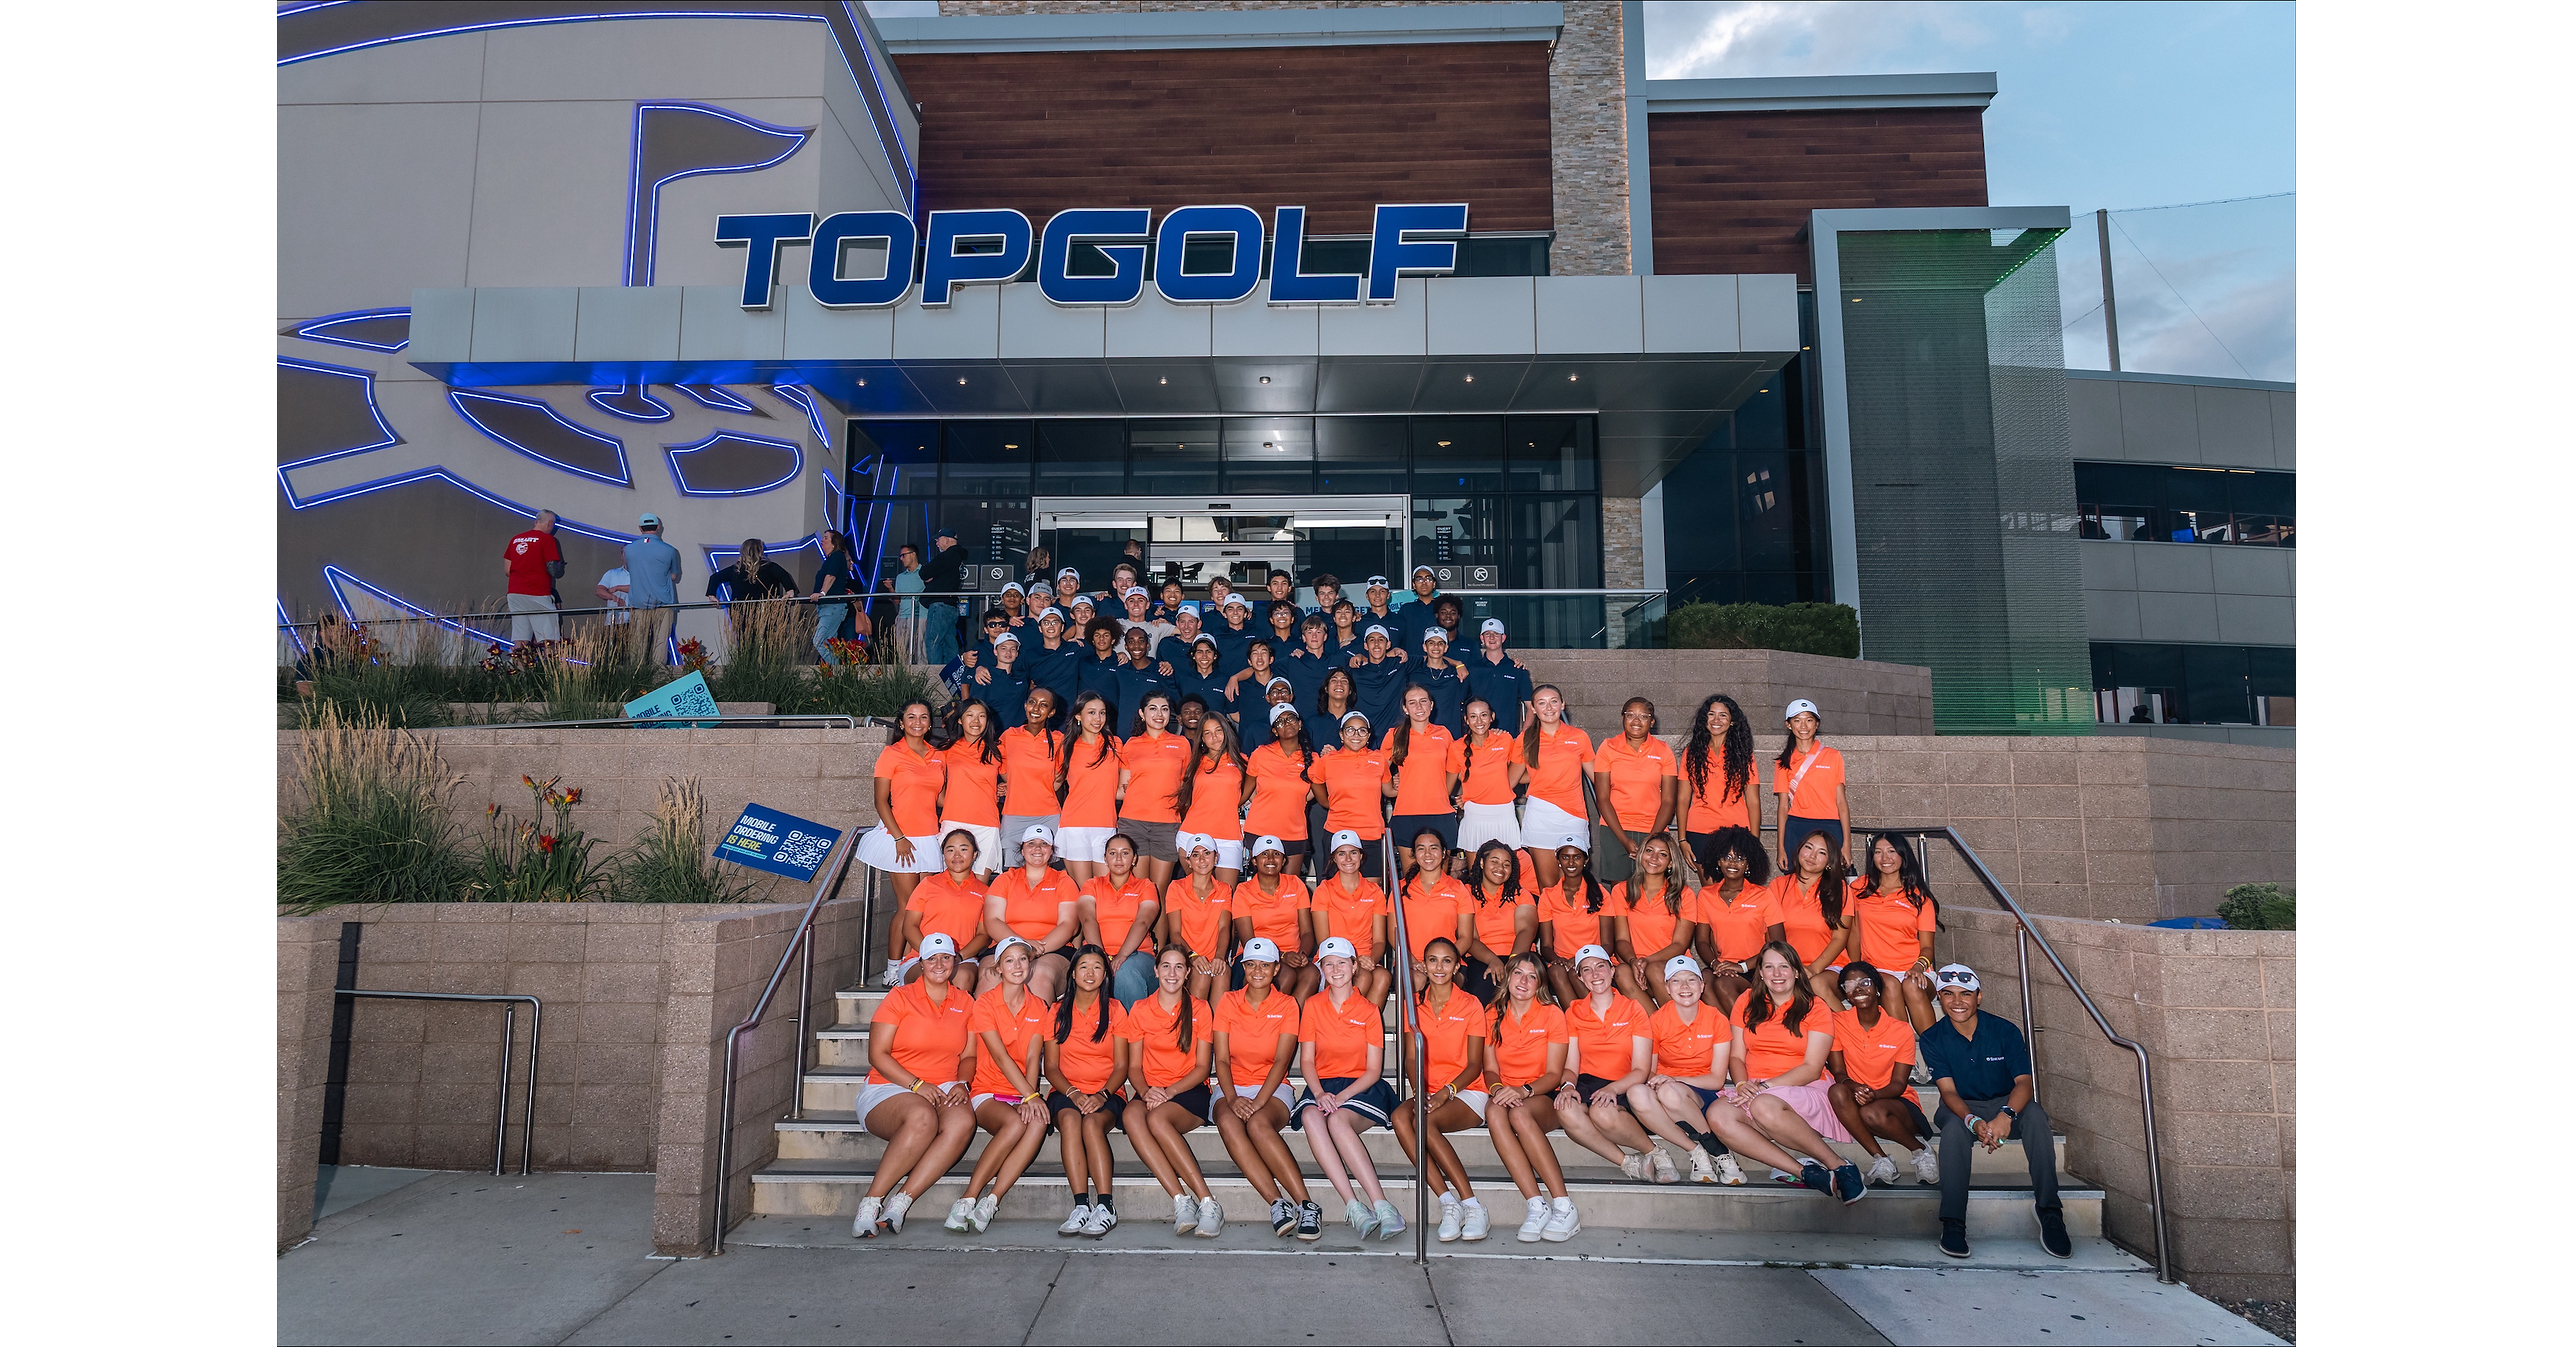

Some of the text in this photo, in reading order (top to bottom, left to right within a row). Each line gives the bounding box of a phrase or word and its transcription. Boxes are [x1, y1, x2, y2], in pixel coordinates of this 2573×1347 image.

[714, 203, 1469, 312] TOPGOLF
[740, 815, 777, 833] MOBILE
[726, 834, 763, 852] IS HERE.
[733, 825, 780, 845] ORDERING
